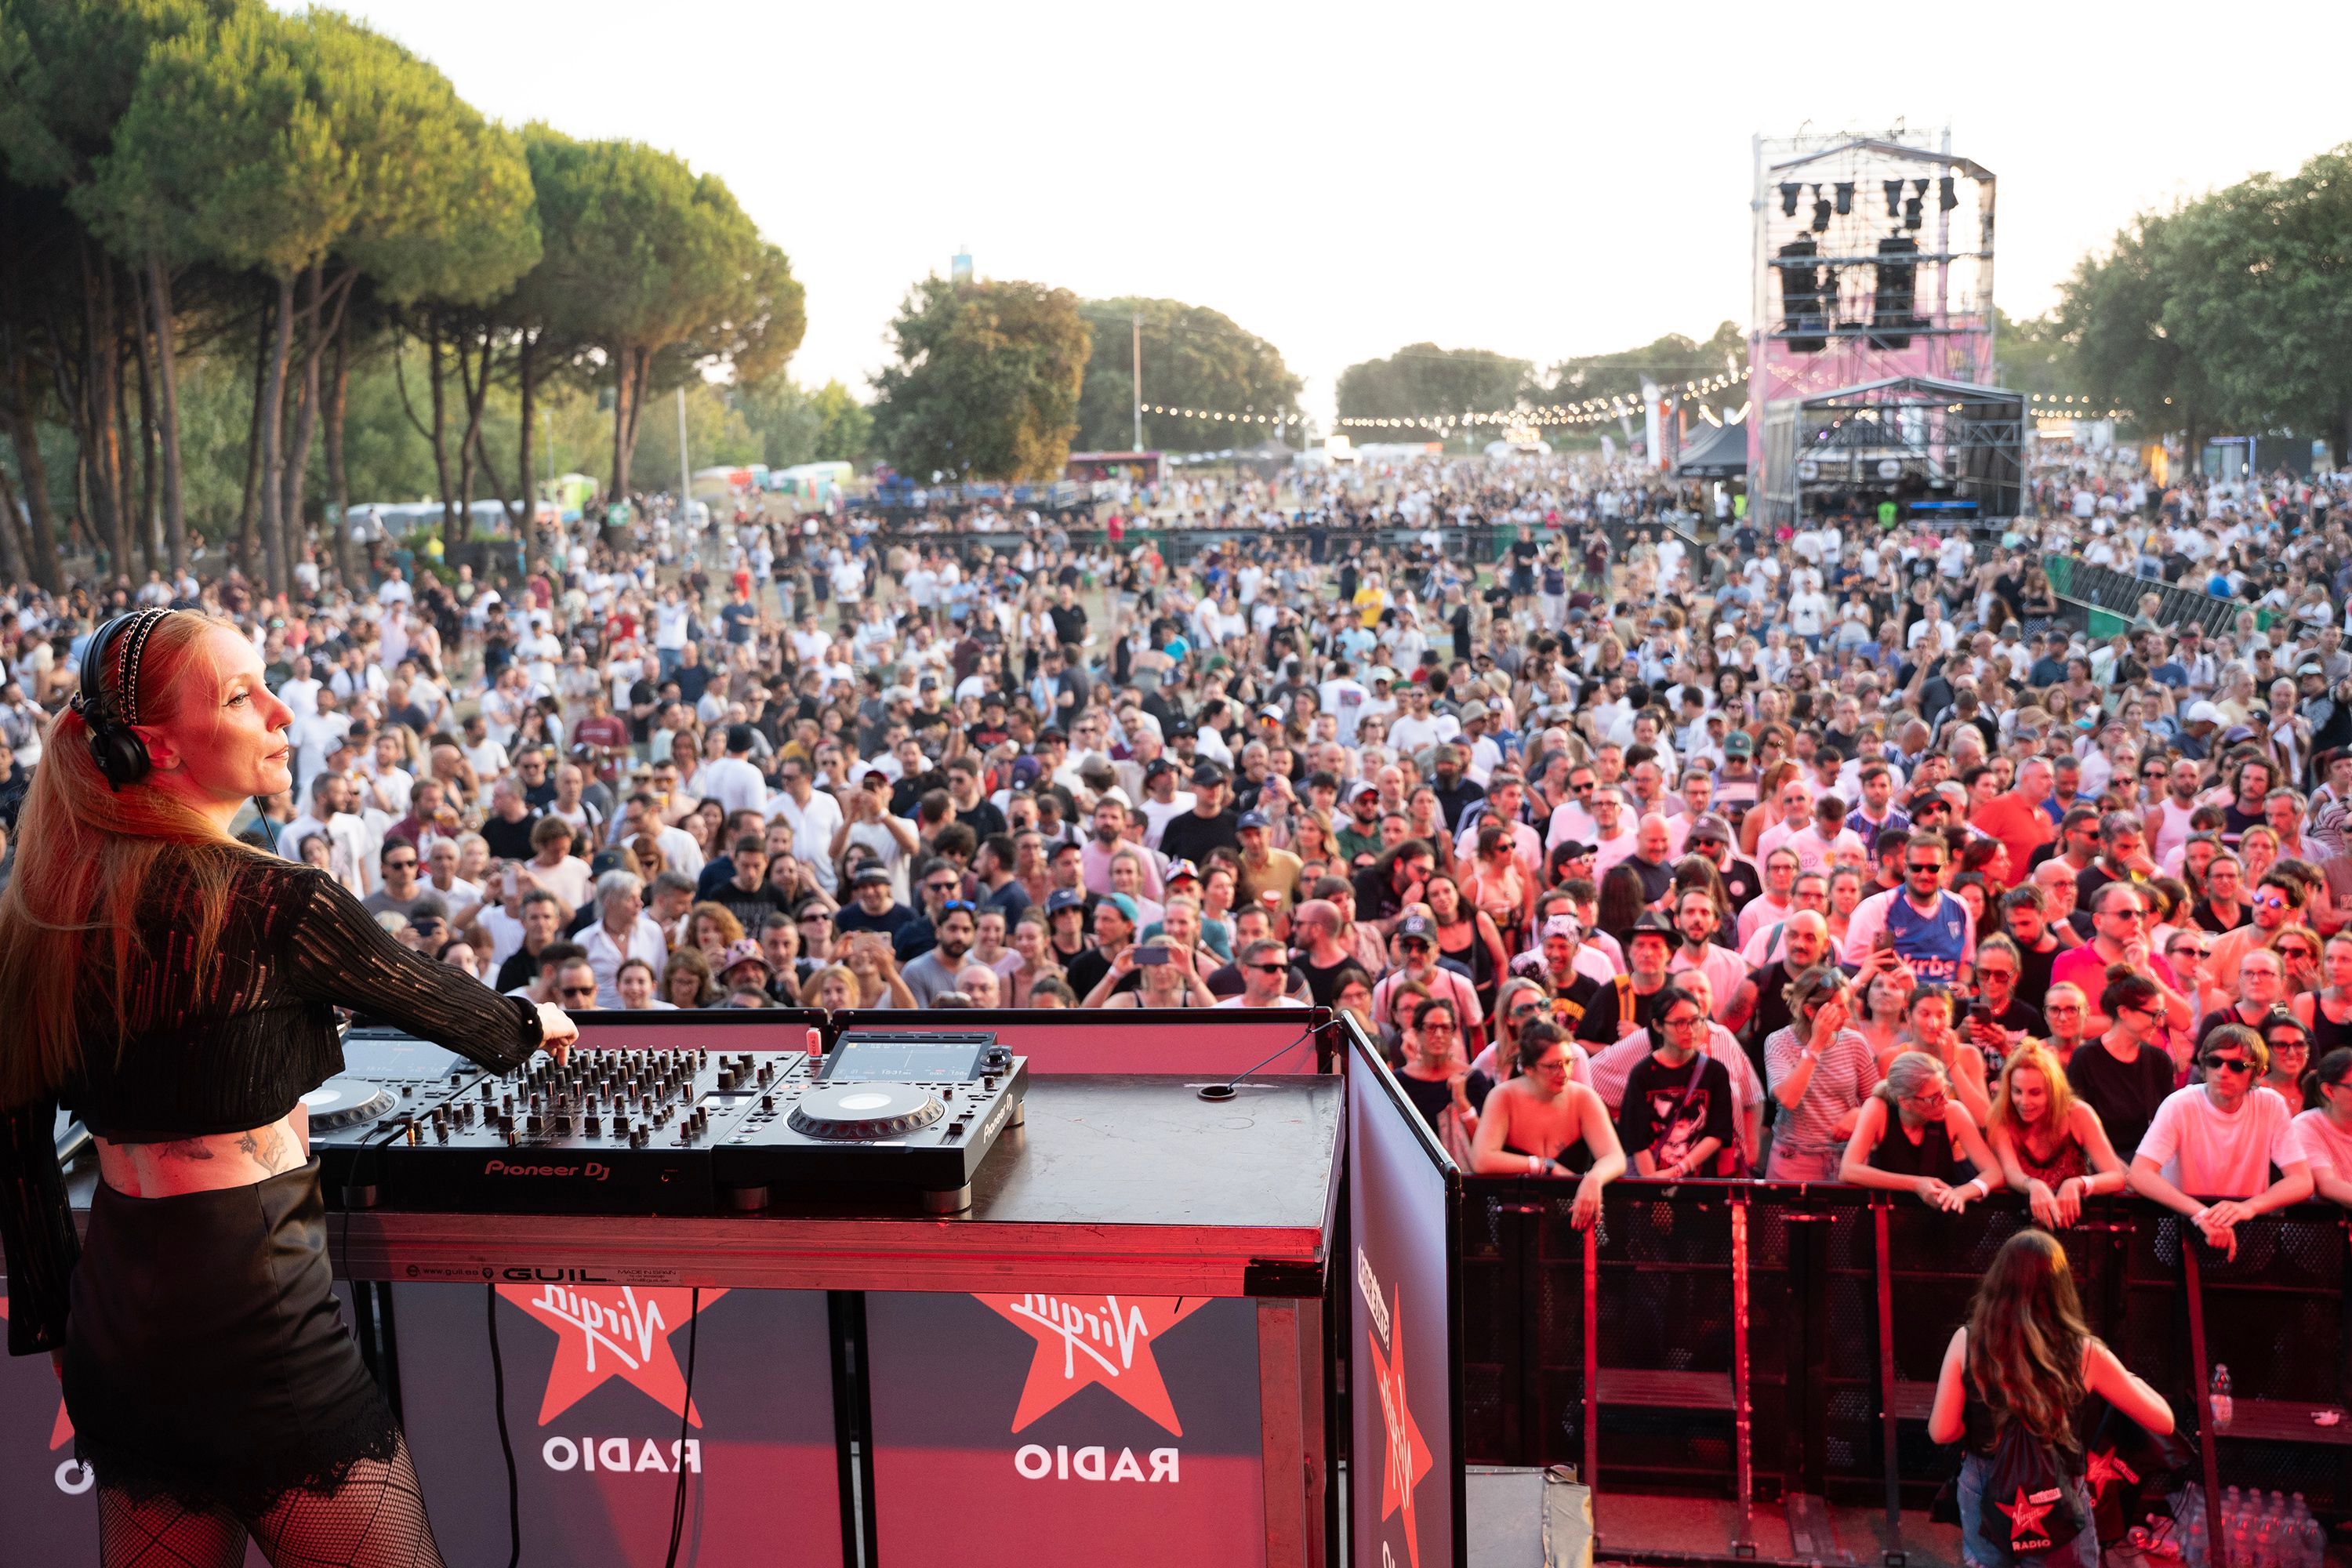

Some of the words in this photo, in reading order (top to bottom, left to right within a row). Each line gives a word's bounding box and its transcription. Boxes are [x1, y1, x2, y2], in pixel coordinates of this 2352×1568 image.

[485, 1160, 579, 1176] Pioneer
[503, 1267, 608, 1281] GUIL
[2012, 1502, 2044, 1529] Virgin
[2012, 1539, 2052, 1552] RADIO
